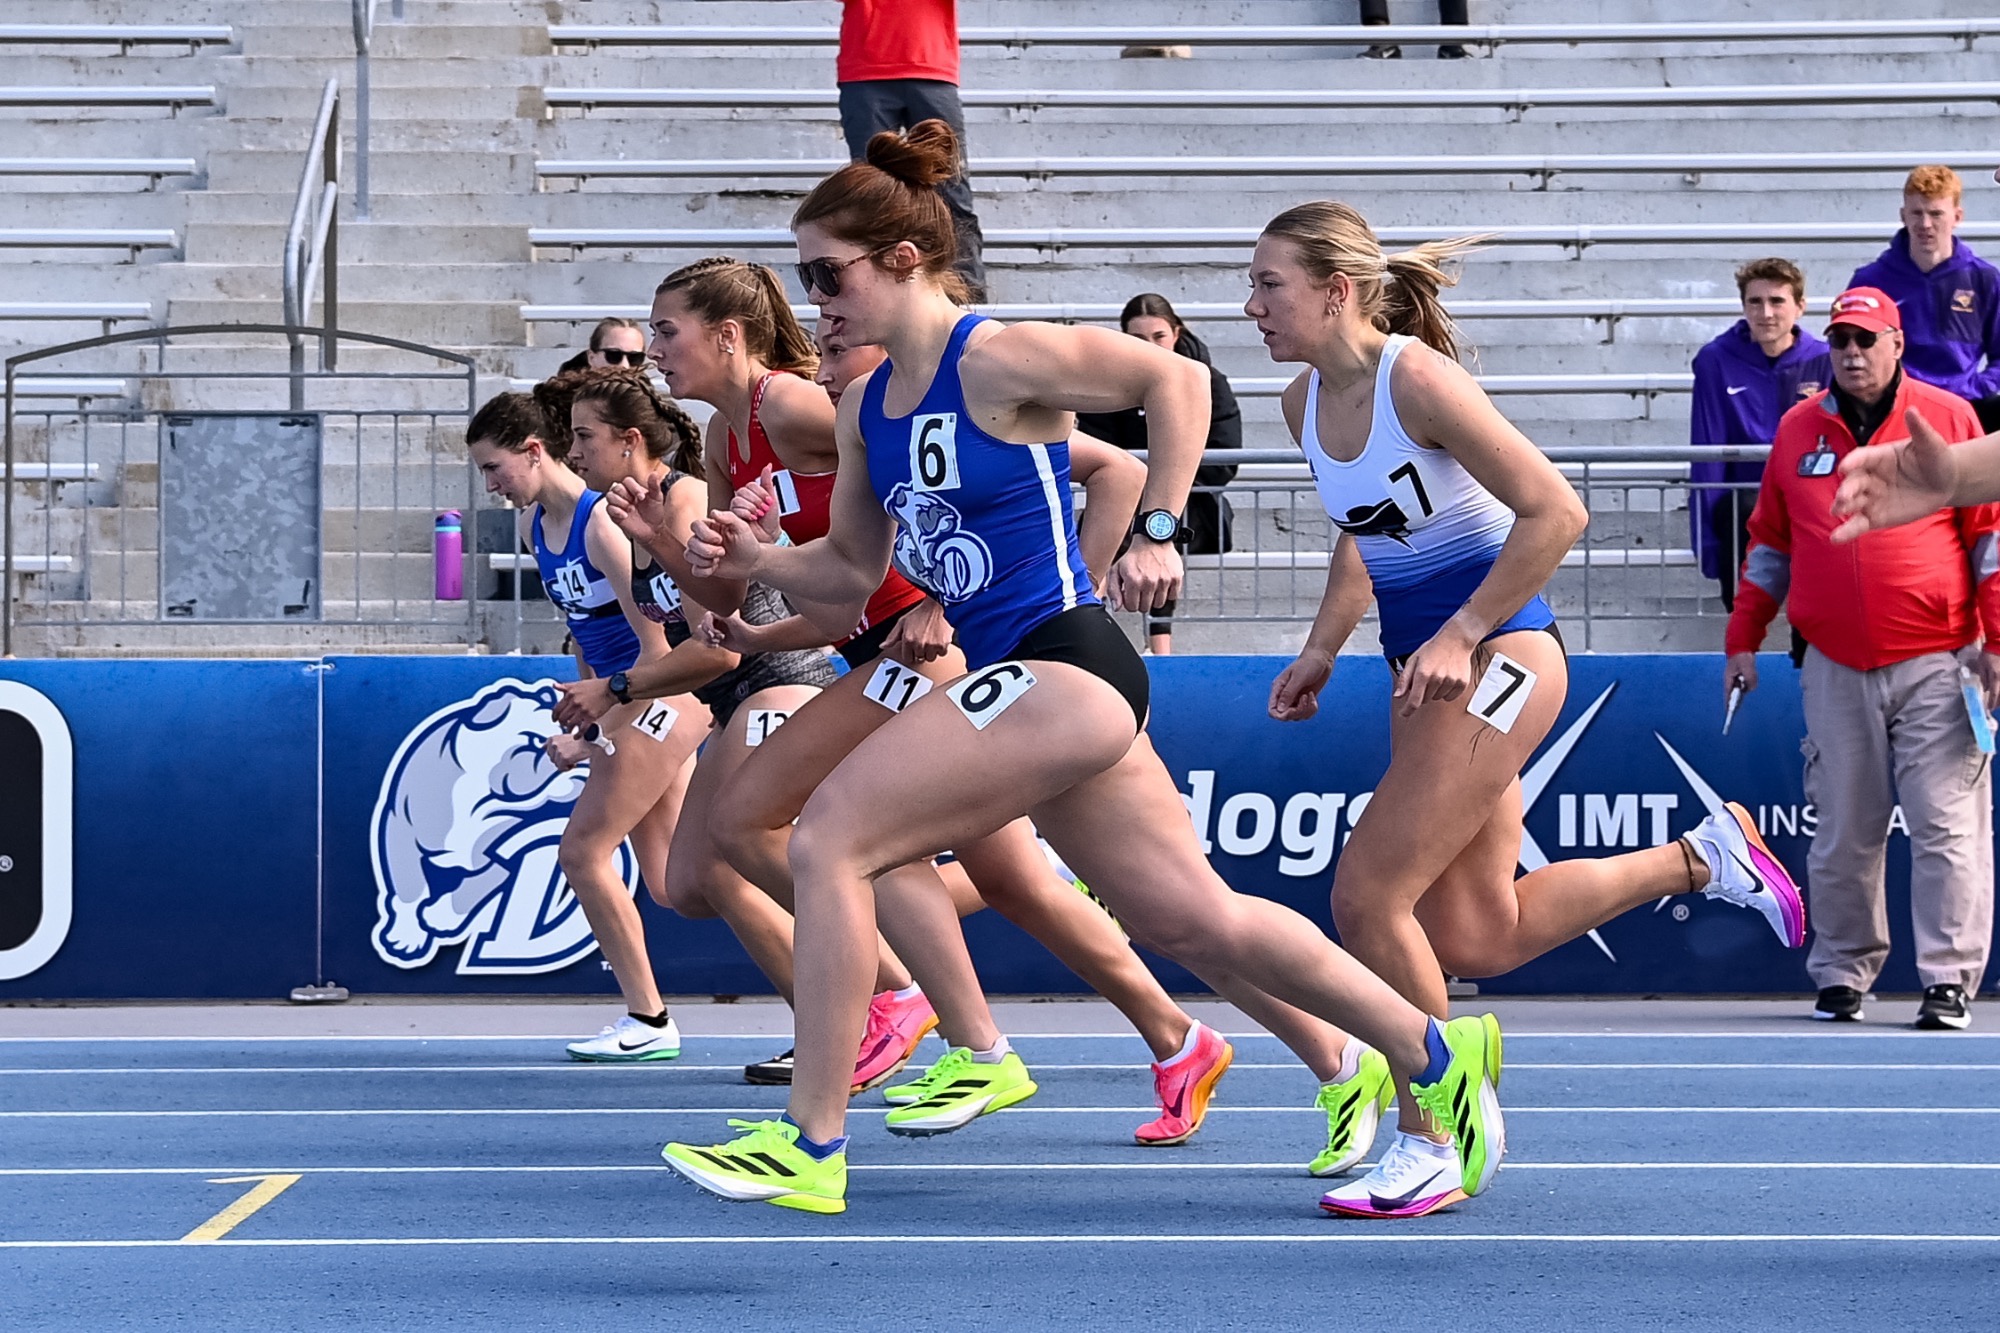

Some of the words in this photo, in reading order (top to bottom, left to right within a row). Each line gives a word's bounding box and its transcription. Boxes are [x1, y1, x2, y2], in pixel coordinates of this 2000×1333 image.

[917, 418, 946, 488] 6
[771, 474, 787, 514] 1
[1388, 460, 1434, 518] 7
[562, 569, 586, 599] 14
[878, 666, 920, 712] 11
[960, 664, 1024, 713] 6
[1481, 661, 1526, 718] 7
[637, 702, 669, 735] 14
[1559, 793, 1679, 847] IMT
